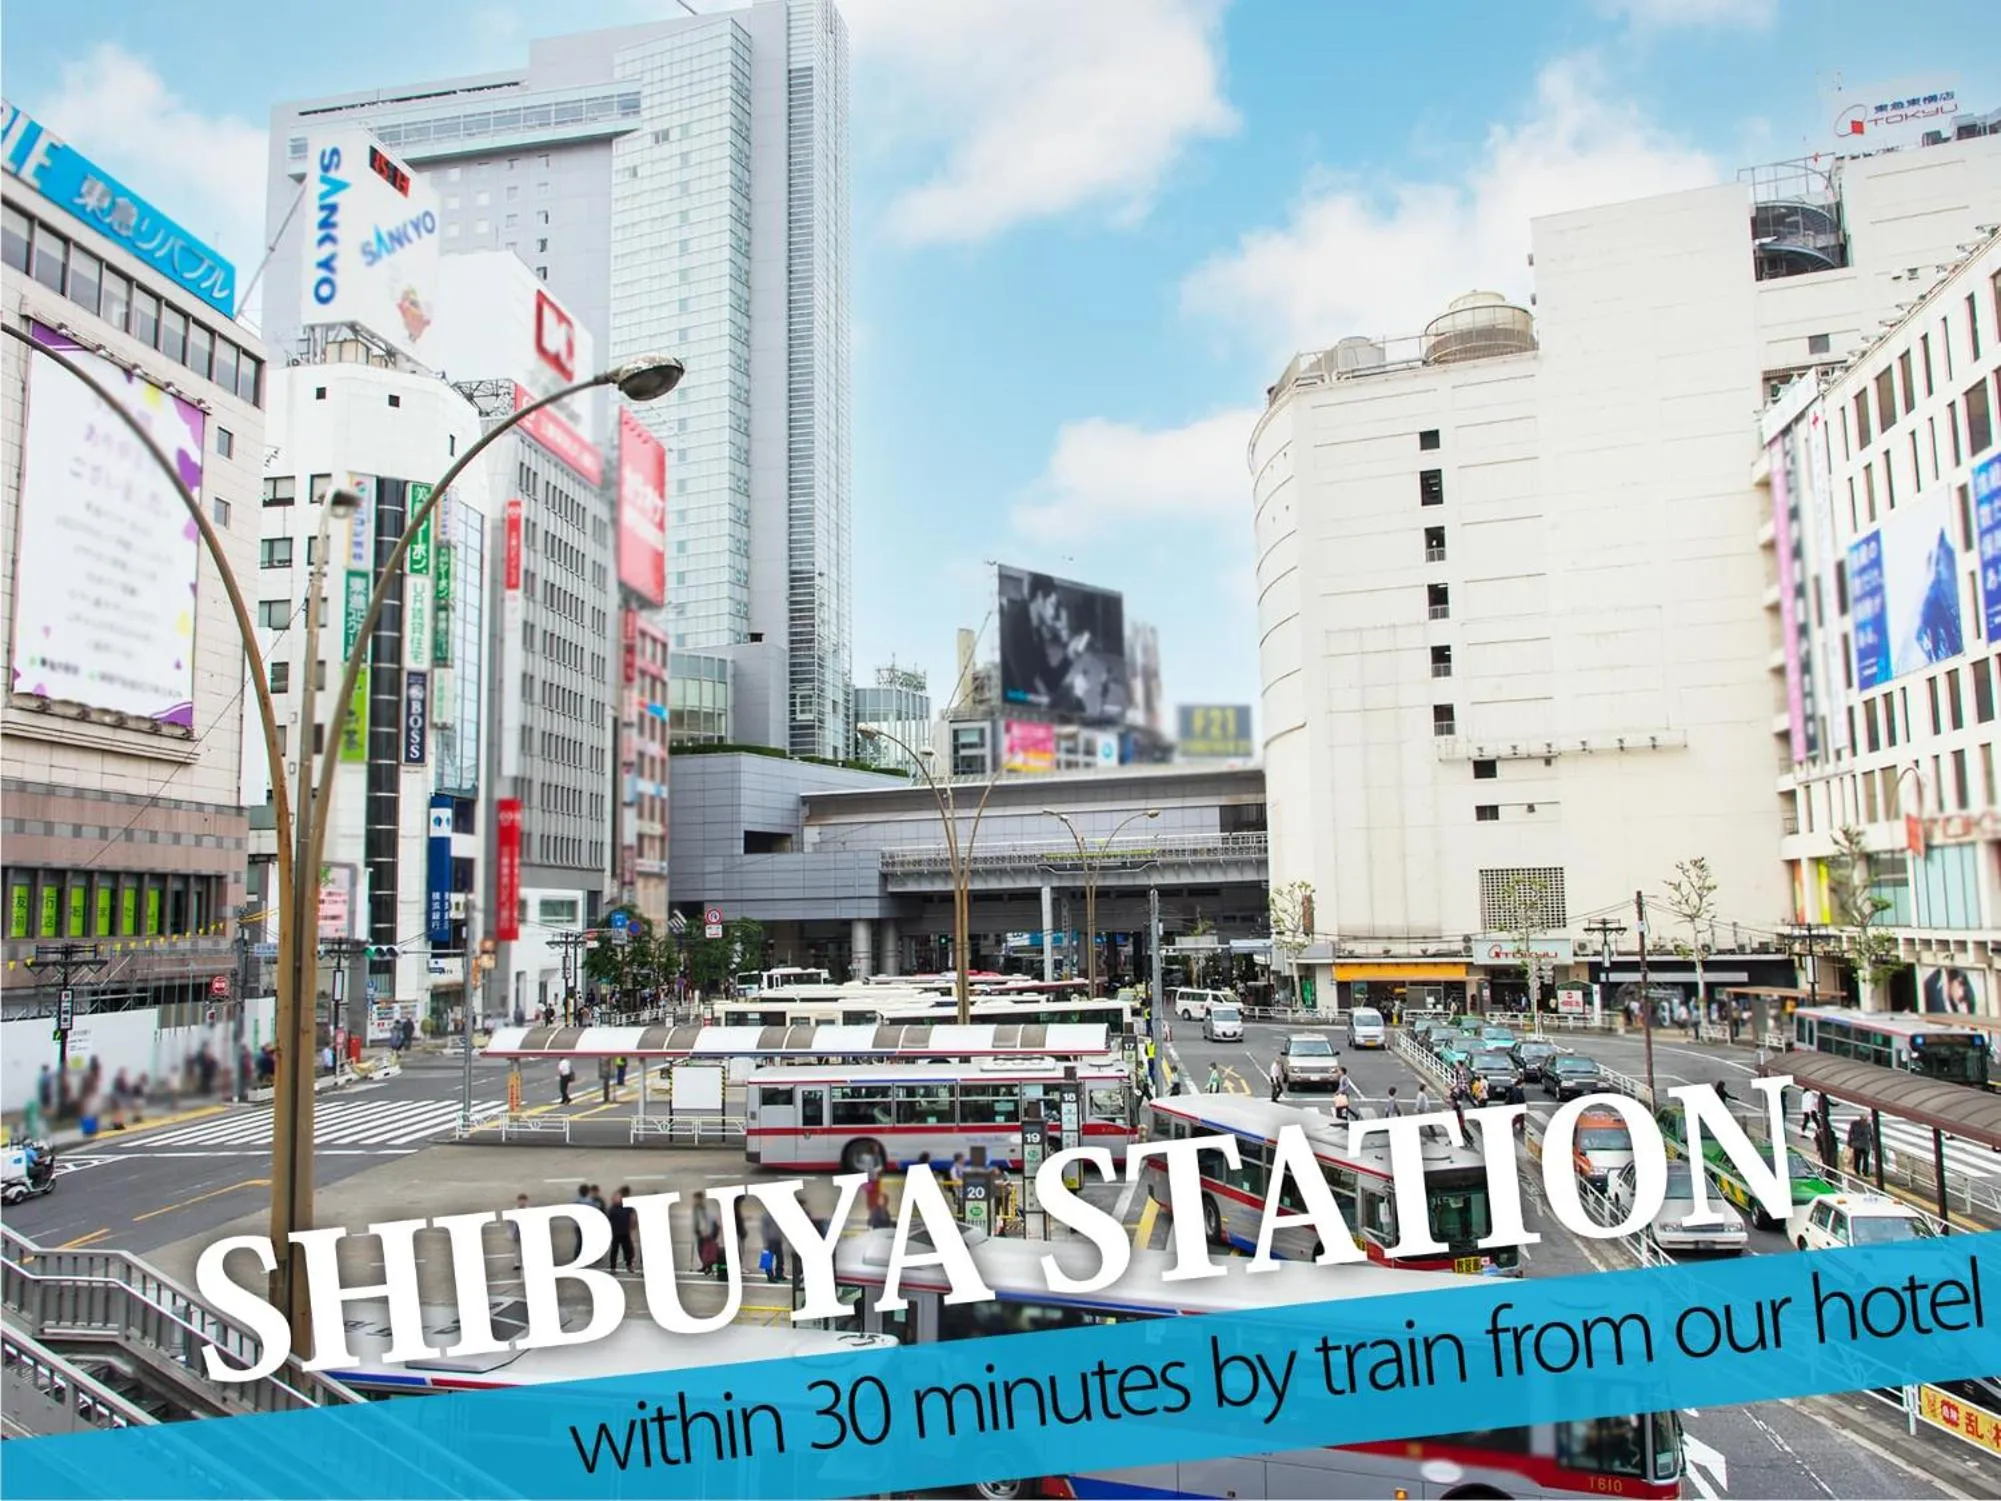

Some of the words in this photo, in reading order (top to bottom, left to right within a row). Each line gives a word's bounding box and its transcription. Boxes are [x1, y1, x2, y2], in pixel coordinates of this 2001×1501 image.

[314, 146, 351, 305] SANKYO
[361, 210, 435, 267] SANKYO
[409, 701, 423, 759] BOSS
[1025, 1133, 1041, 1144] 19
[966, 1186, 985, 1200] 20
